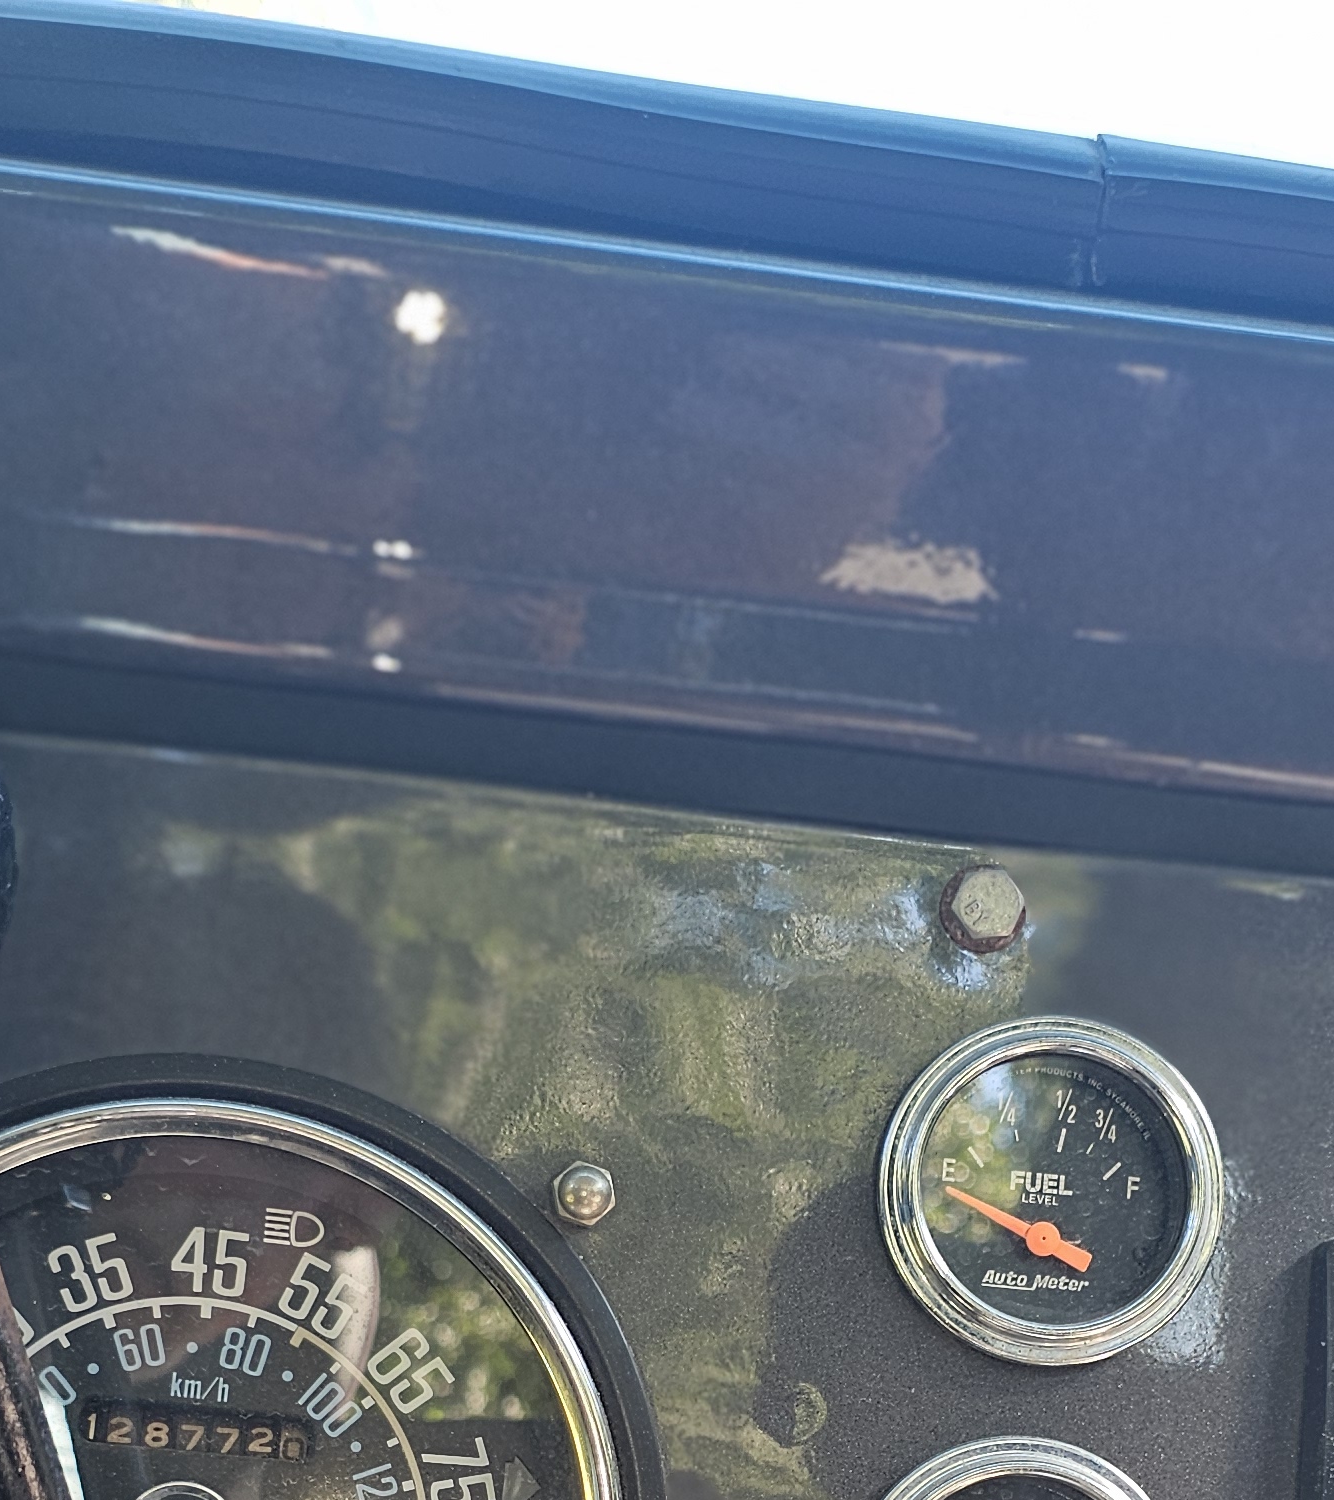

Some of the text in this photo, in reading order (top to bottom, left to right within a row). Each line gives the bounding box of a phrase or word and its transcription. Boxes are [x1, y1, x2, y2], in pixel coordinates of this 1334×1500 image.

[1056, 1088, 1077, 1124] 1/2
[1095, 1107, 1117, 1143] 3/4
[942, 1158, 957, 1183] E
[1010, 1170, 1074, 1197] FUEL
[1021, 1194, 1060, 1206] LEVEL
[1126, 1175, 1141, 1200] F
[981, 1268, 1090, 1292] Auto Meter
[48, 1232, 134, 1313] 35
[171, 1226, 250, 1297] 45
[278, 1252, 368, 1340] 55
[367, 1327, 456, 1414] 65
[113, 1323, 166, 1372] 60
[219, 1327, 272, 1377] 80
[298, 1372, 363, 1438] 100
[170, 1371, 230, 1403] km/h
